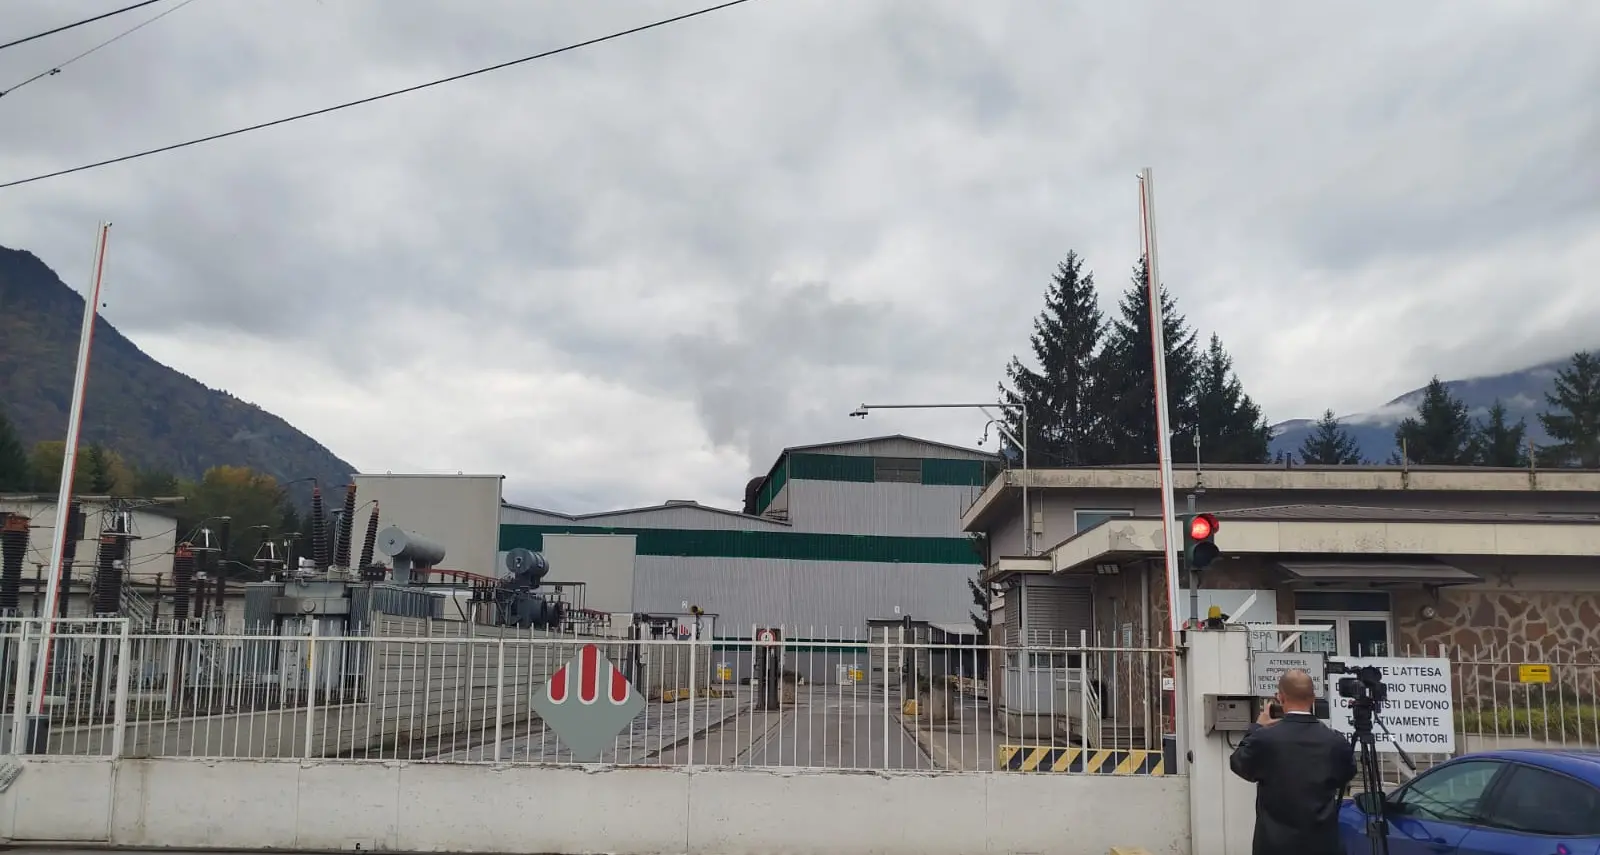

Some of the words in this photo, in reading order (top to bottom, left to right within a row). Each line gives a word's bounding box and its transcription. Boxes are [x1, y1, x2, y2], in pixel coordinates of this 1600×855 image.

[1392, 666, 1442, 677] L'ATTESA
[1409, 683, 1447, 693] TURNO
[1404, 700, 1449, 710] DEVONO
[1406, 733, 1448, 744] MOTORI
